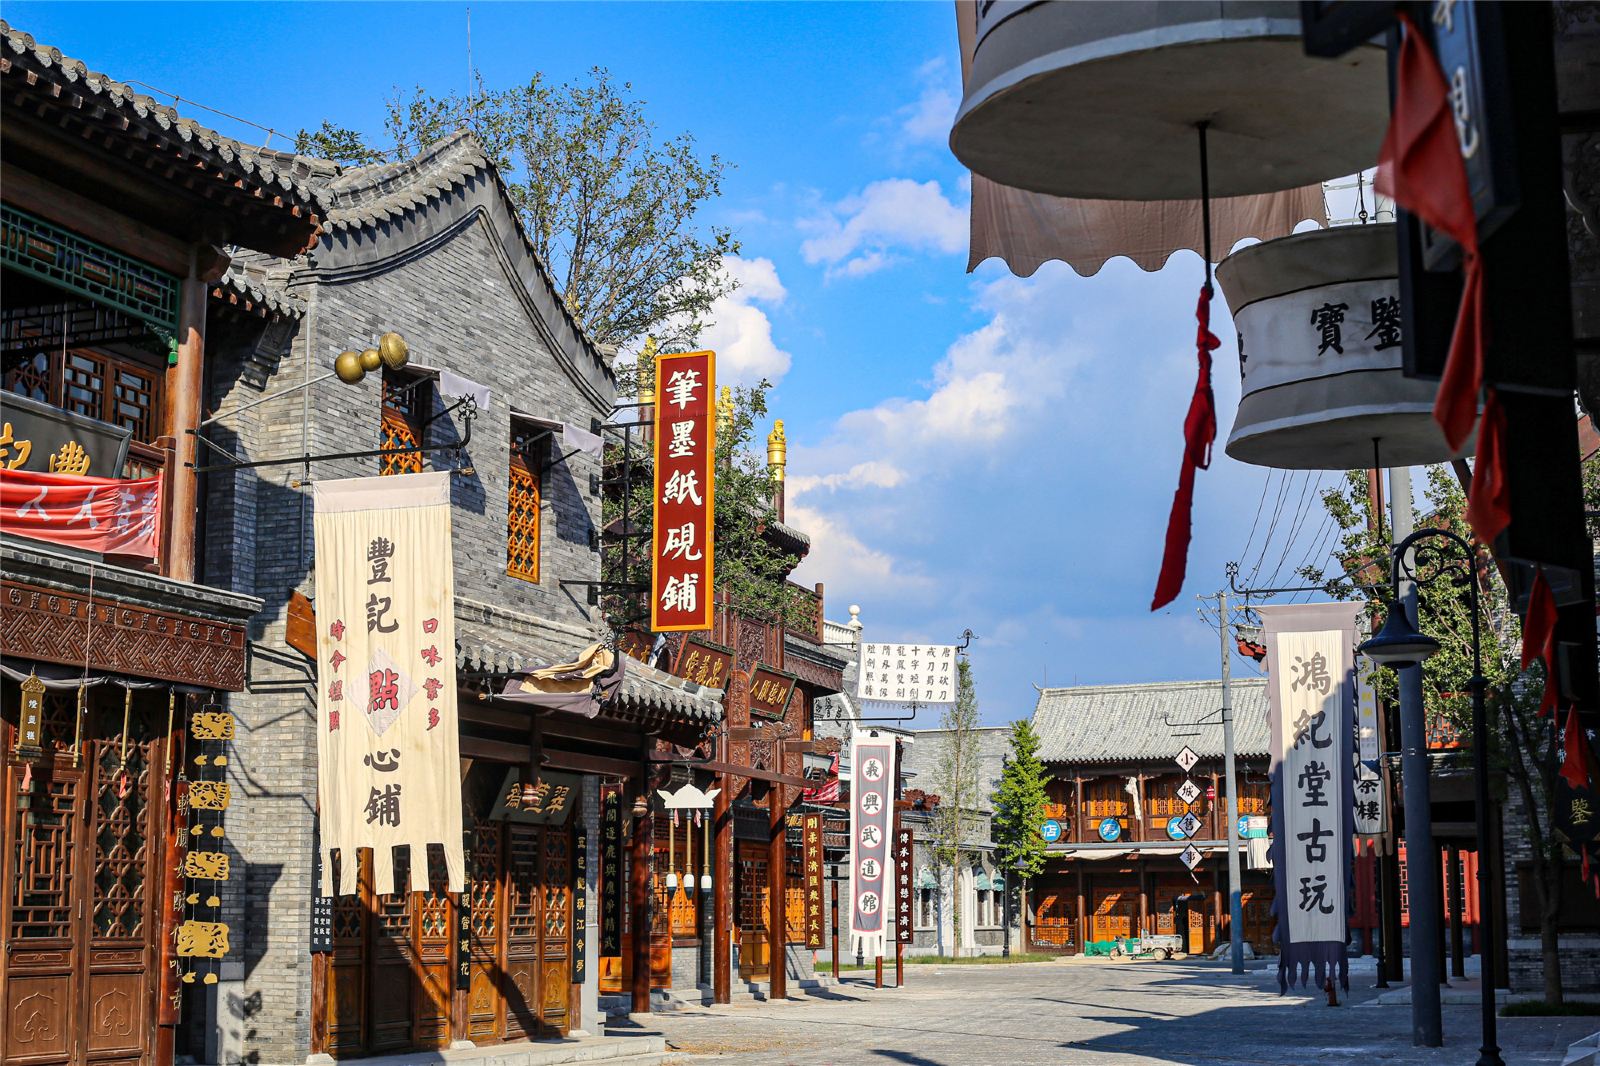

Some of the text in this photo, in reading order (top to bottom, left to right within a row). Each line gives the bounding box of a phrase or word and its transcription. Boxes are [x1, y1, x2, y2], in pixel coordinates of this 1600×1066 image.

[660, 368, 703, 614] 筆墨紙硯鋪
[421, 617, 445, 732] 口味繁多
[861, 759, 880, 913] 義興武道館
[1180, 752, 1197, 864] 小城舊事
[1290, 651, 1335, 915] 鴻紀堂古玩
